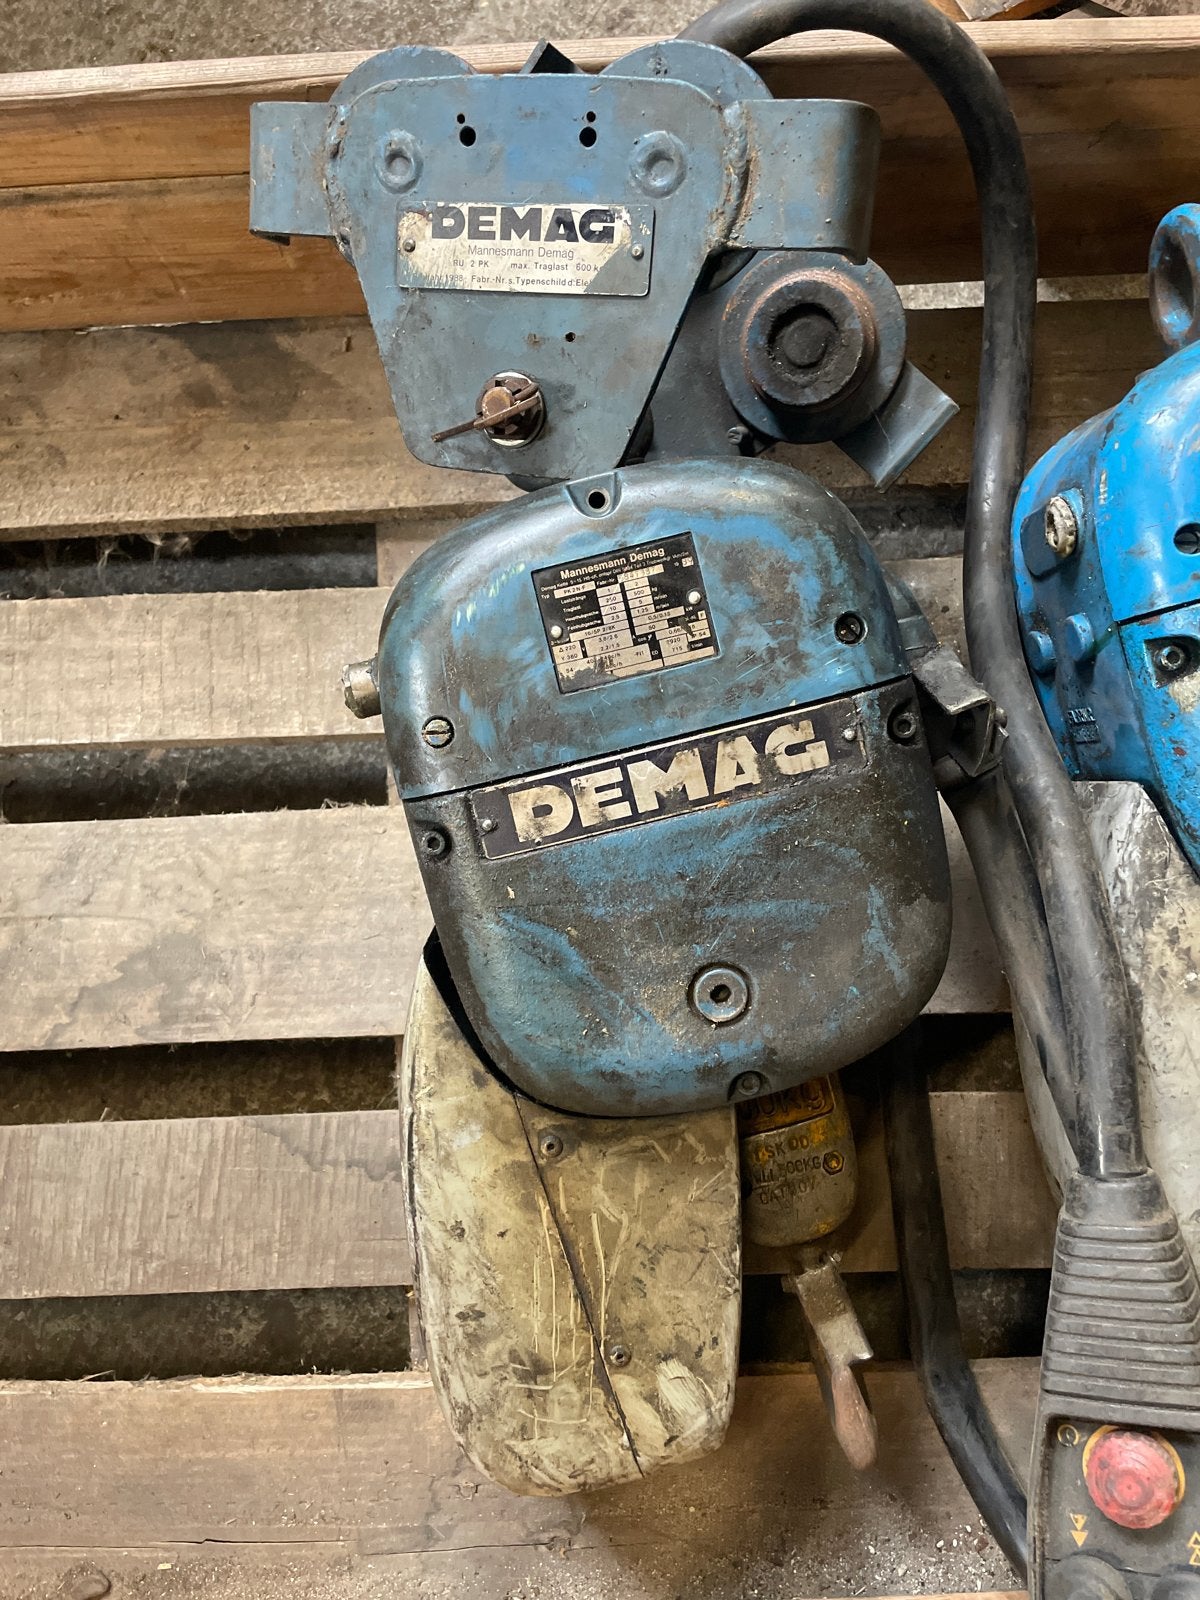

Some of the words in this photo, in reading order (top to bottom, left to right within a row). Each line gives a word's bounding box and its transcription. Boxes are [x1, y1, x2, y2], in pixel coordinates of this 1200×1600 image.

[431, 207, 616, 244] DEMAG
[453, 259, 465, 267] RU
[478, 260, 489, 268] PK
[534, 262, 569, 272] Traglast
[575, 264, 592, 272] 600
[467, 245, 534, 257] Mannesmann
[538, 247, 575, 260] Demag
[560, 558, 627, 580] Mannesmann
[629, 547, 665, 563] Demag
[508, 719, 830, 843] DEMAG
